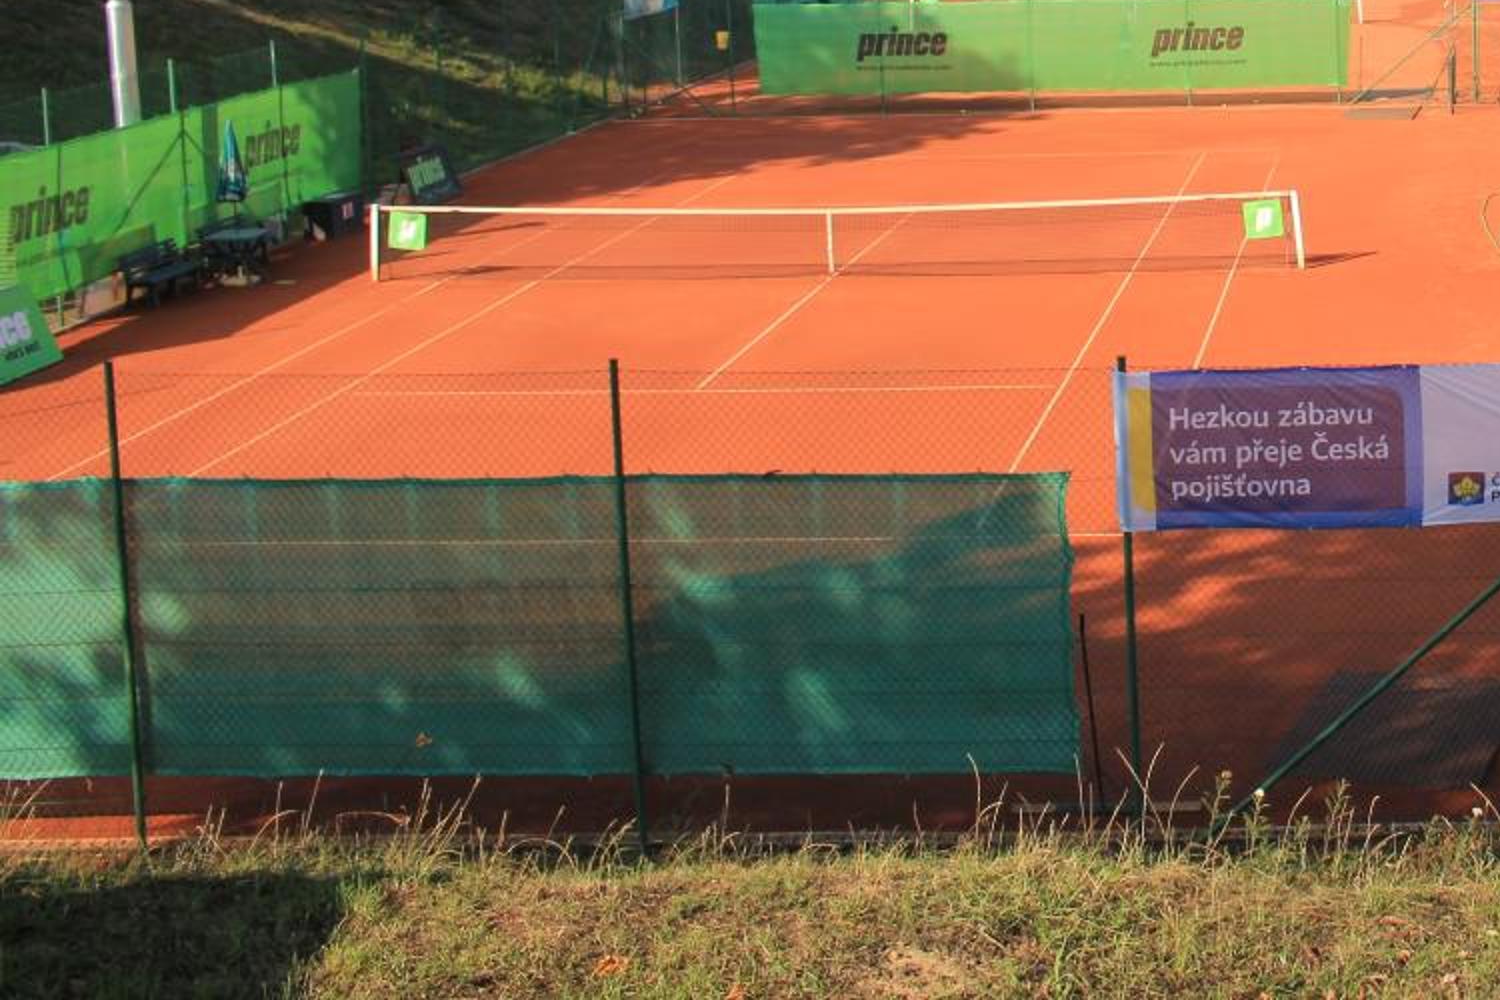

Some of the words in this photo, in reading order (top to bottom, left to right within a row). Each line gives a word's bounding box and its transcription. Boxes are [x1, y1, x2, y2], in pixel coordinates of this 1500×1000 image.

[857, 25, 948, 62] prince
[1152, 21, 1245, 56] prince
[8, 185, 89, 245] prince
[1169, 404, 1269, 430] Hezkou
[1278, 401, 1374, 428] zábavu
[1170, 440, 1227, 465] vám
[1236, 438, 1303, 469] přeje
[1311, 432, 1390, 461] Česká
[1172, 473, 1312, 503] pojišťovna
